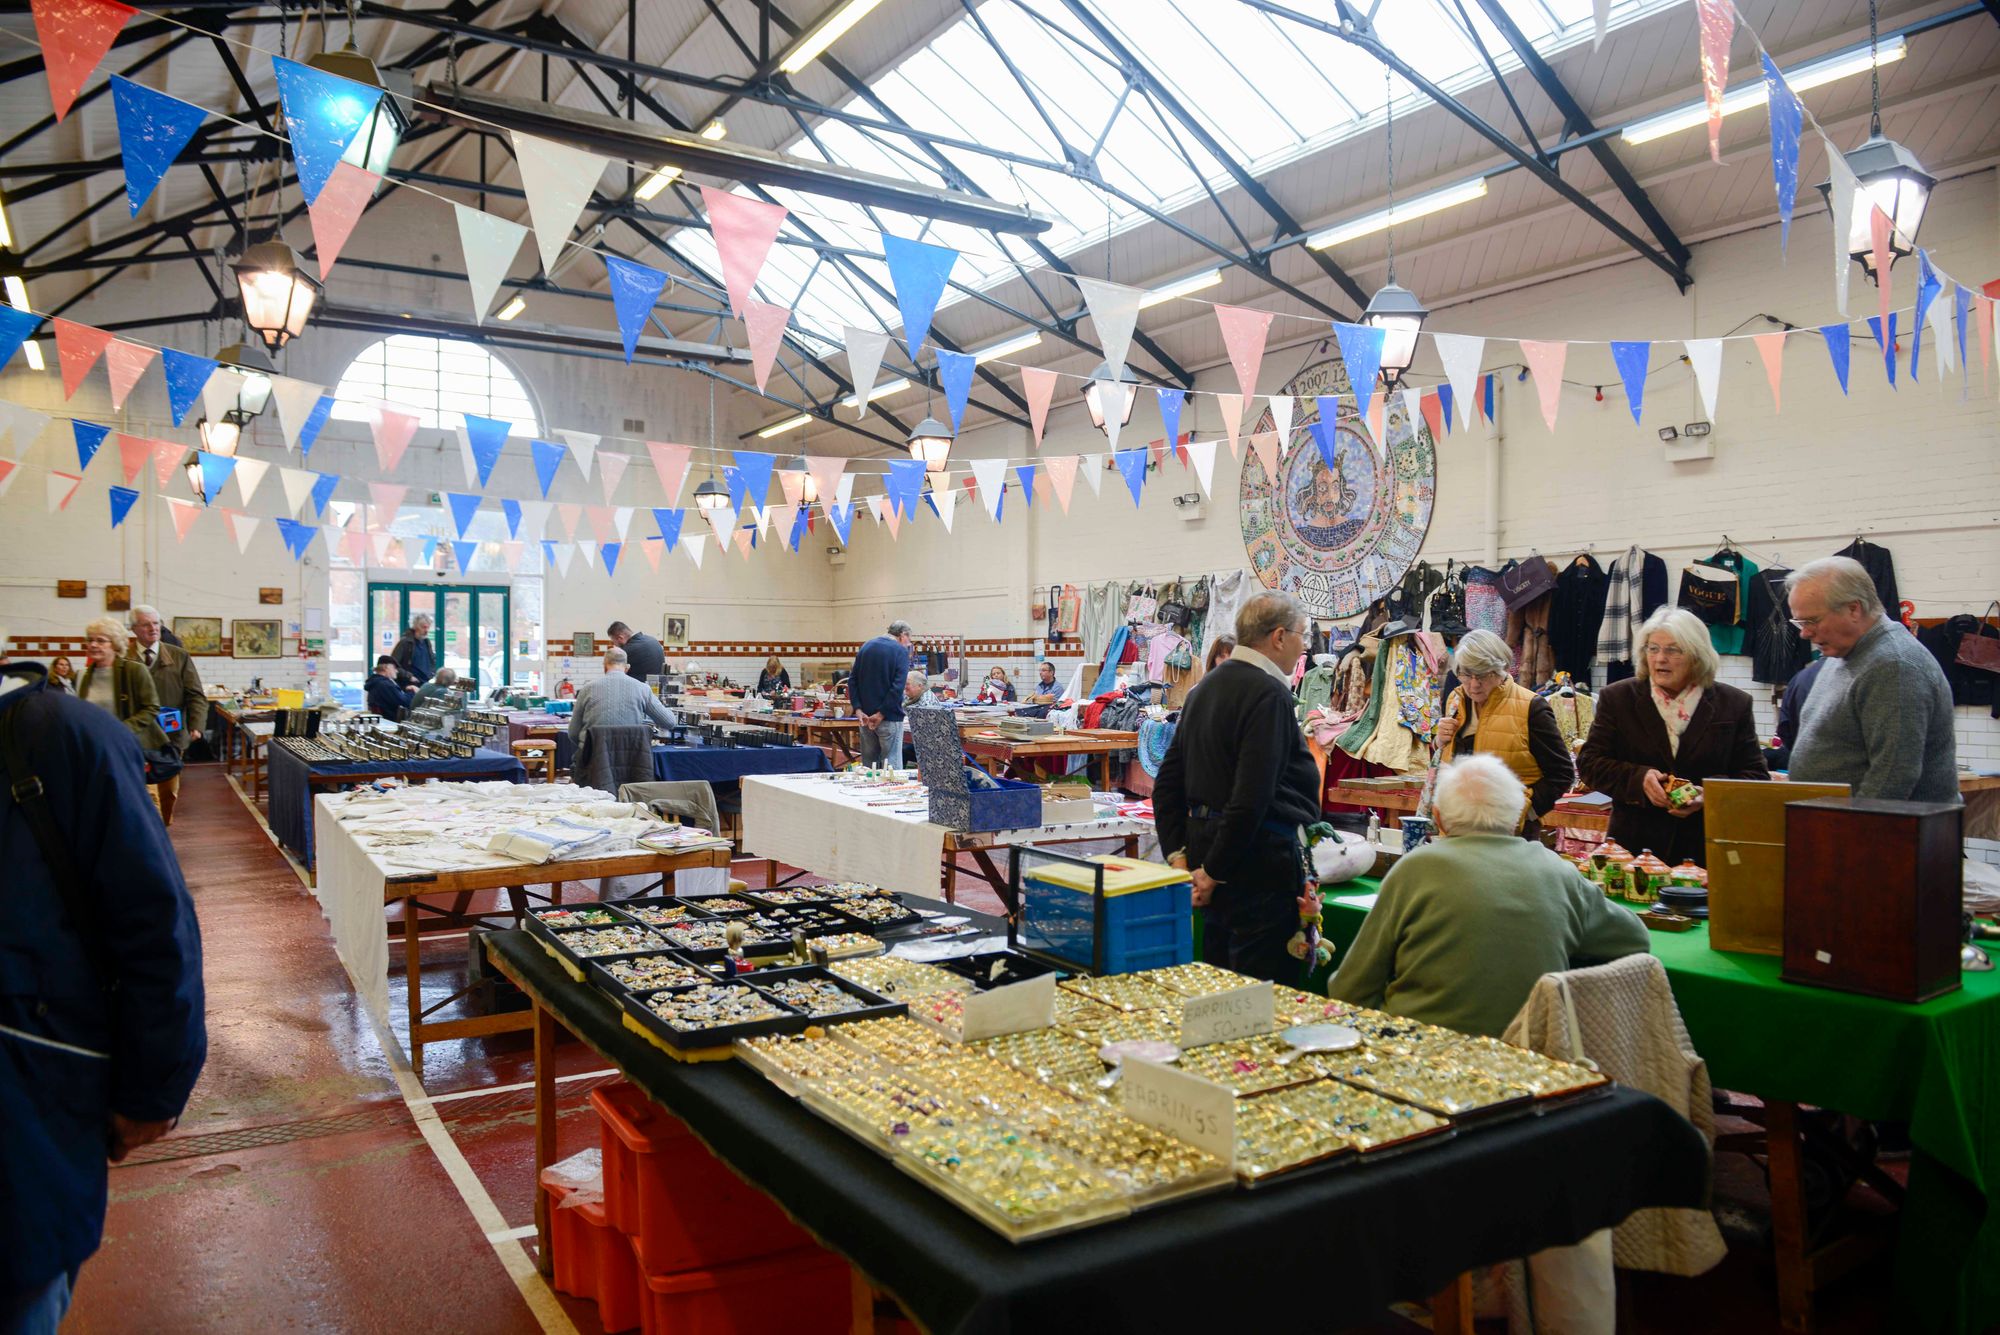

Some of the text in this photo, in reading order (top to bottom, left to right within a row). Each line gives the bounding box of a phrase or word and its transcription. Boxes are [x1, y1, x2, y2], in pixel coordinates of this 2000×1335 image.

[1300, 371, 1328, 395] 2007
[1688, 585, 1727, 601] VOGUE
[1184, 997, 1252, 1023] EARRINGS
[1125, 1080, 1218, 1135] EARRINGS
